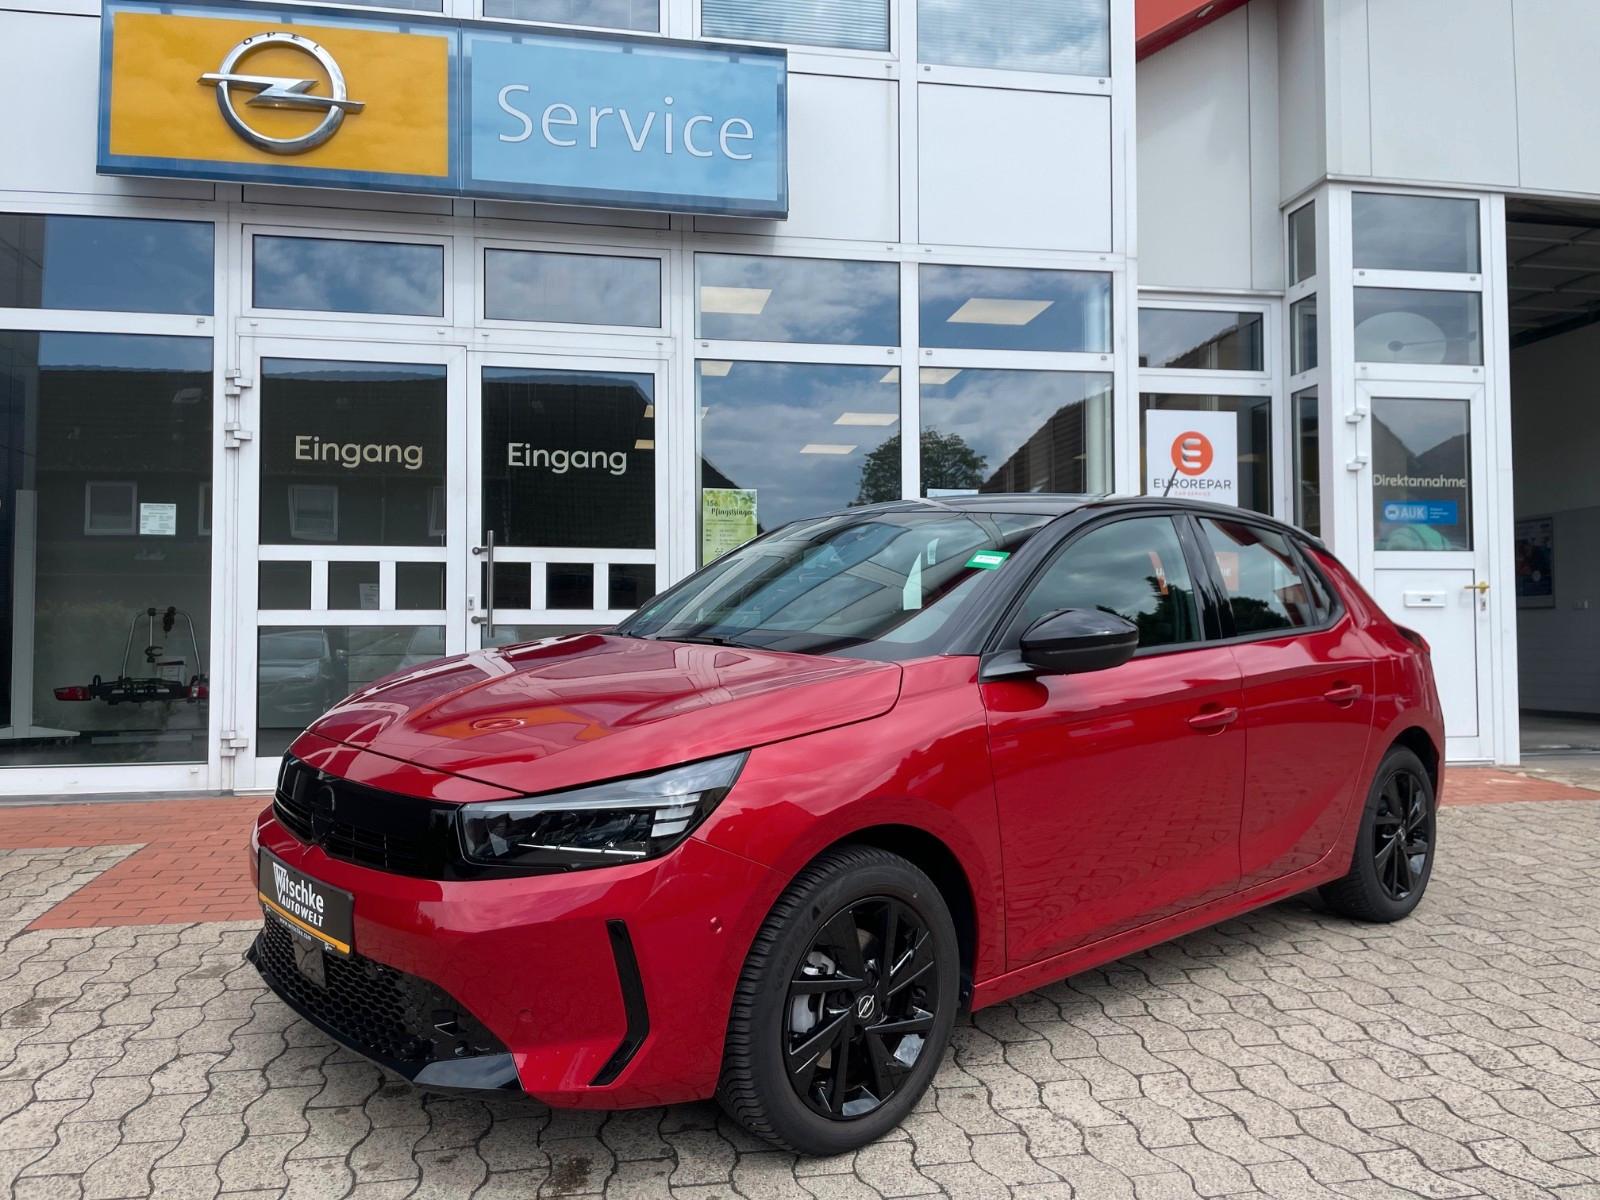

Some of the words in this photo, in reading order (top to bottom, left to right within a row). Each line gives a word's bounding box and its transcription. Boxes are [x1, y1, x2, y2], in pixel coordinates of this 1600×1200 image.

[243, 32, 320, 52] OPEL
[498, 84, 754, 160] Service
[295, 435, 423, 470] Eingang
[508, 442, 627, 475] Eingang
[1153, 478, 1231, 489] EUROREPAR
[1373, 474, 1467, 488] Direktannahme
[273, 861, 324, 913] Witschke
[281, 894, 324, 927] AUTOWELT
